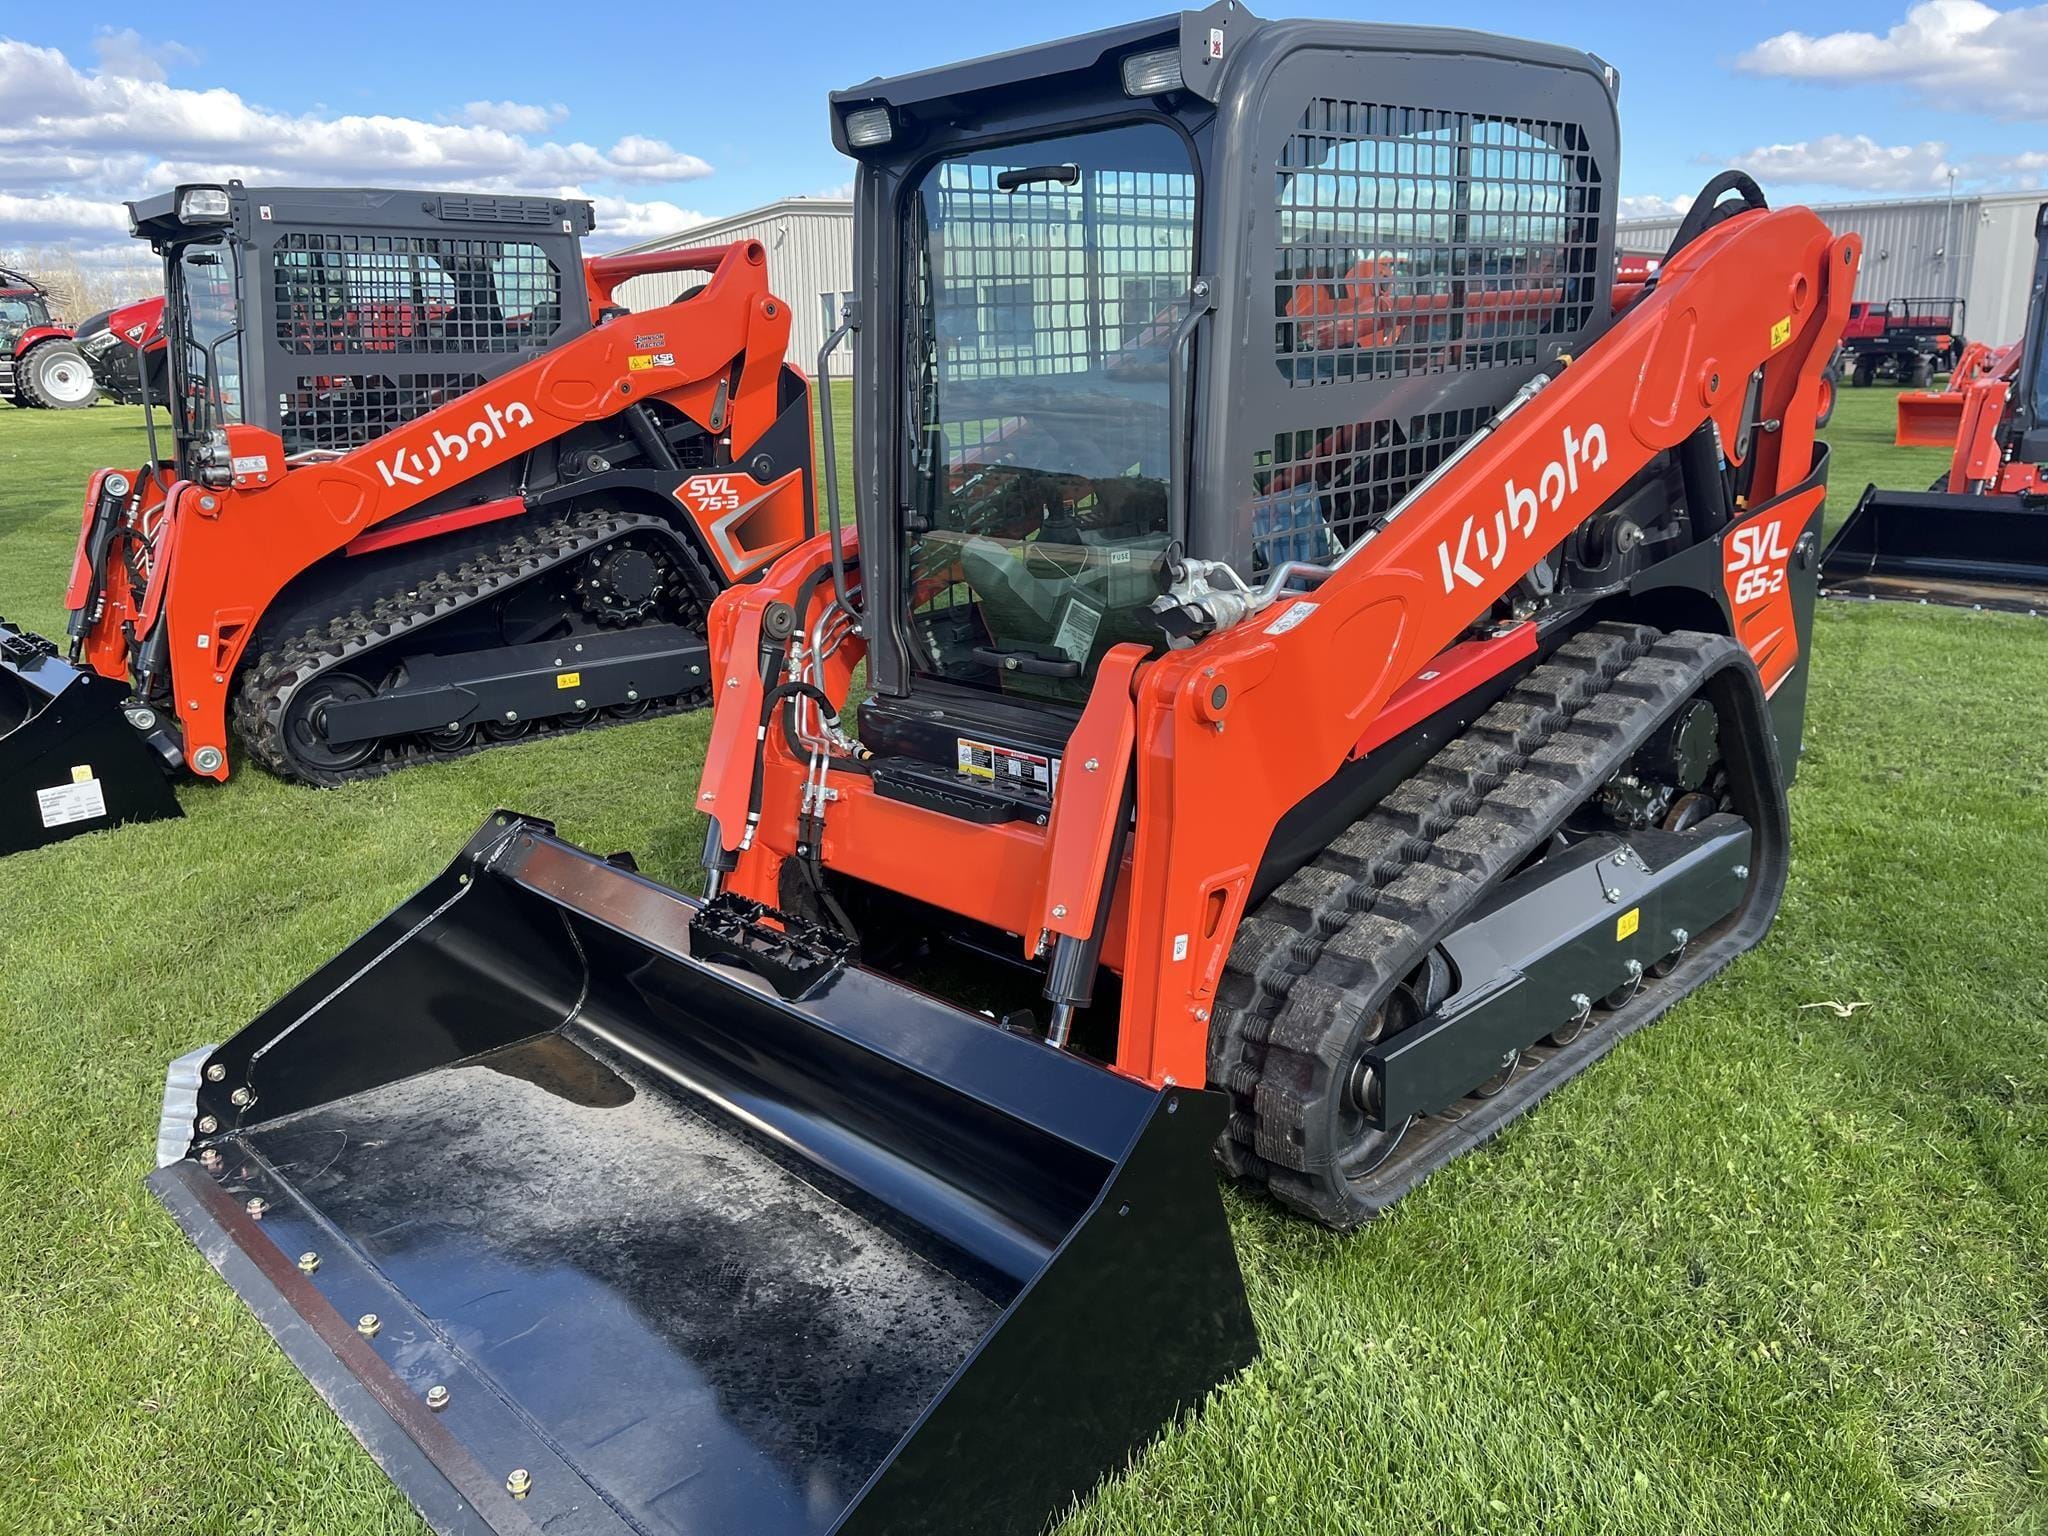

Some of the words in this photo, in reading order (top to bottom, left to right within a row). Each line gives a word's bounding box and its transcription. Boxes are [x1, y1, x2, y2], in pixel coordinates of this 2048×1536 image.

[634, 333, 664, 343] JOHNSON
[635, 341, 665, 349] TRACTOR
[652, 353, 674, 363] KSR
[376, 402, 534, 487] Kubota
[688, 478, 737, 497] SVL
[698, 495, 739, 511] 75-3
[1438, 423, 1608, 595] Kubota
[1727, 520, 1788, 573] SVL
[1735, 565, 1784, 605] 65-2
